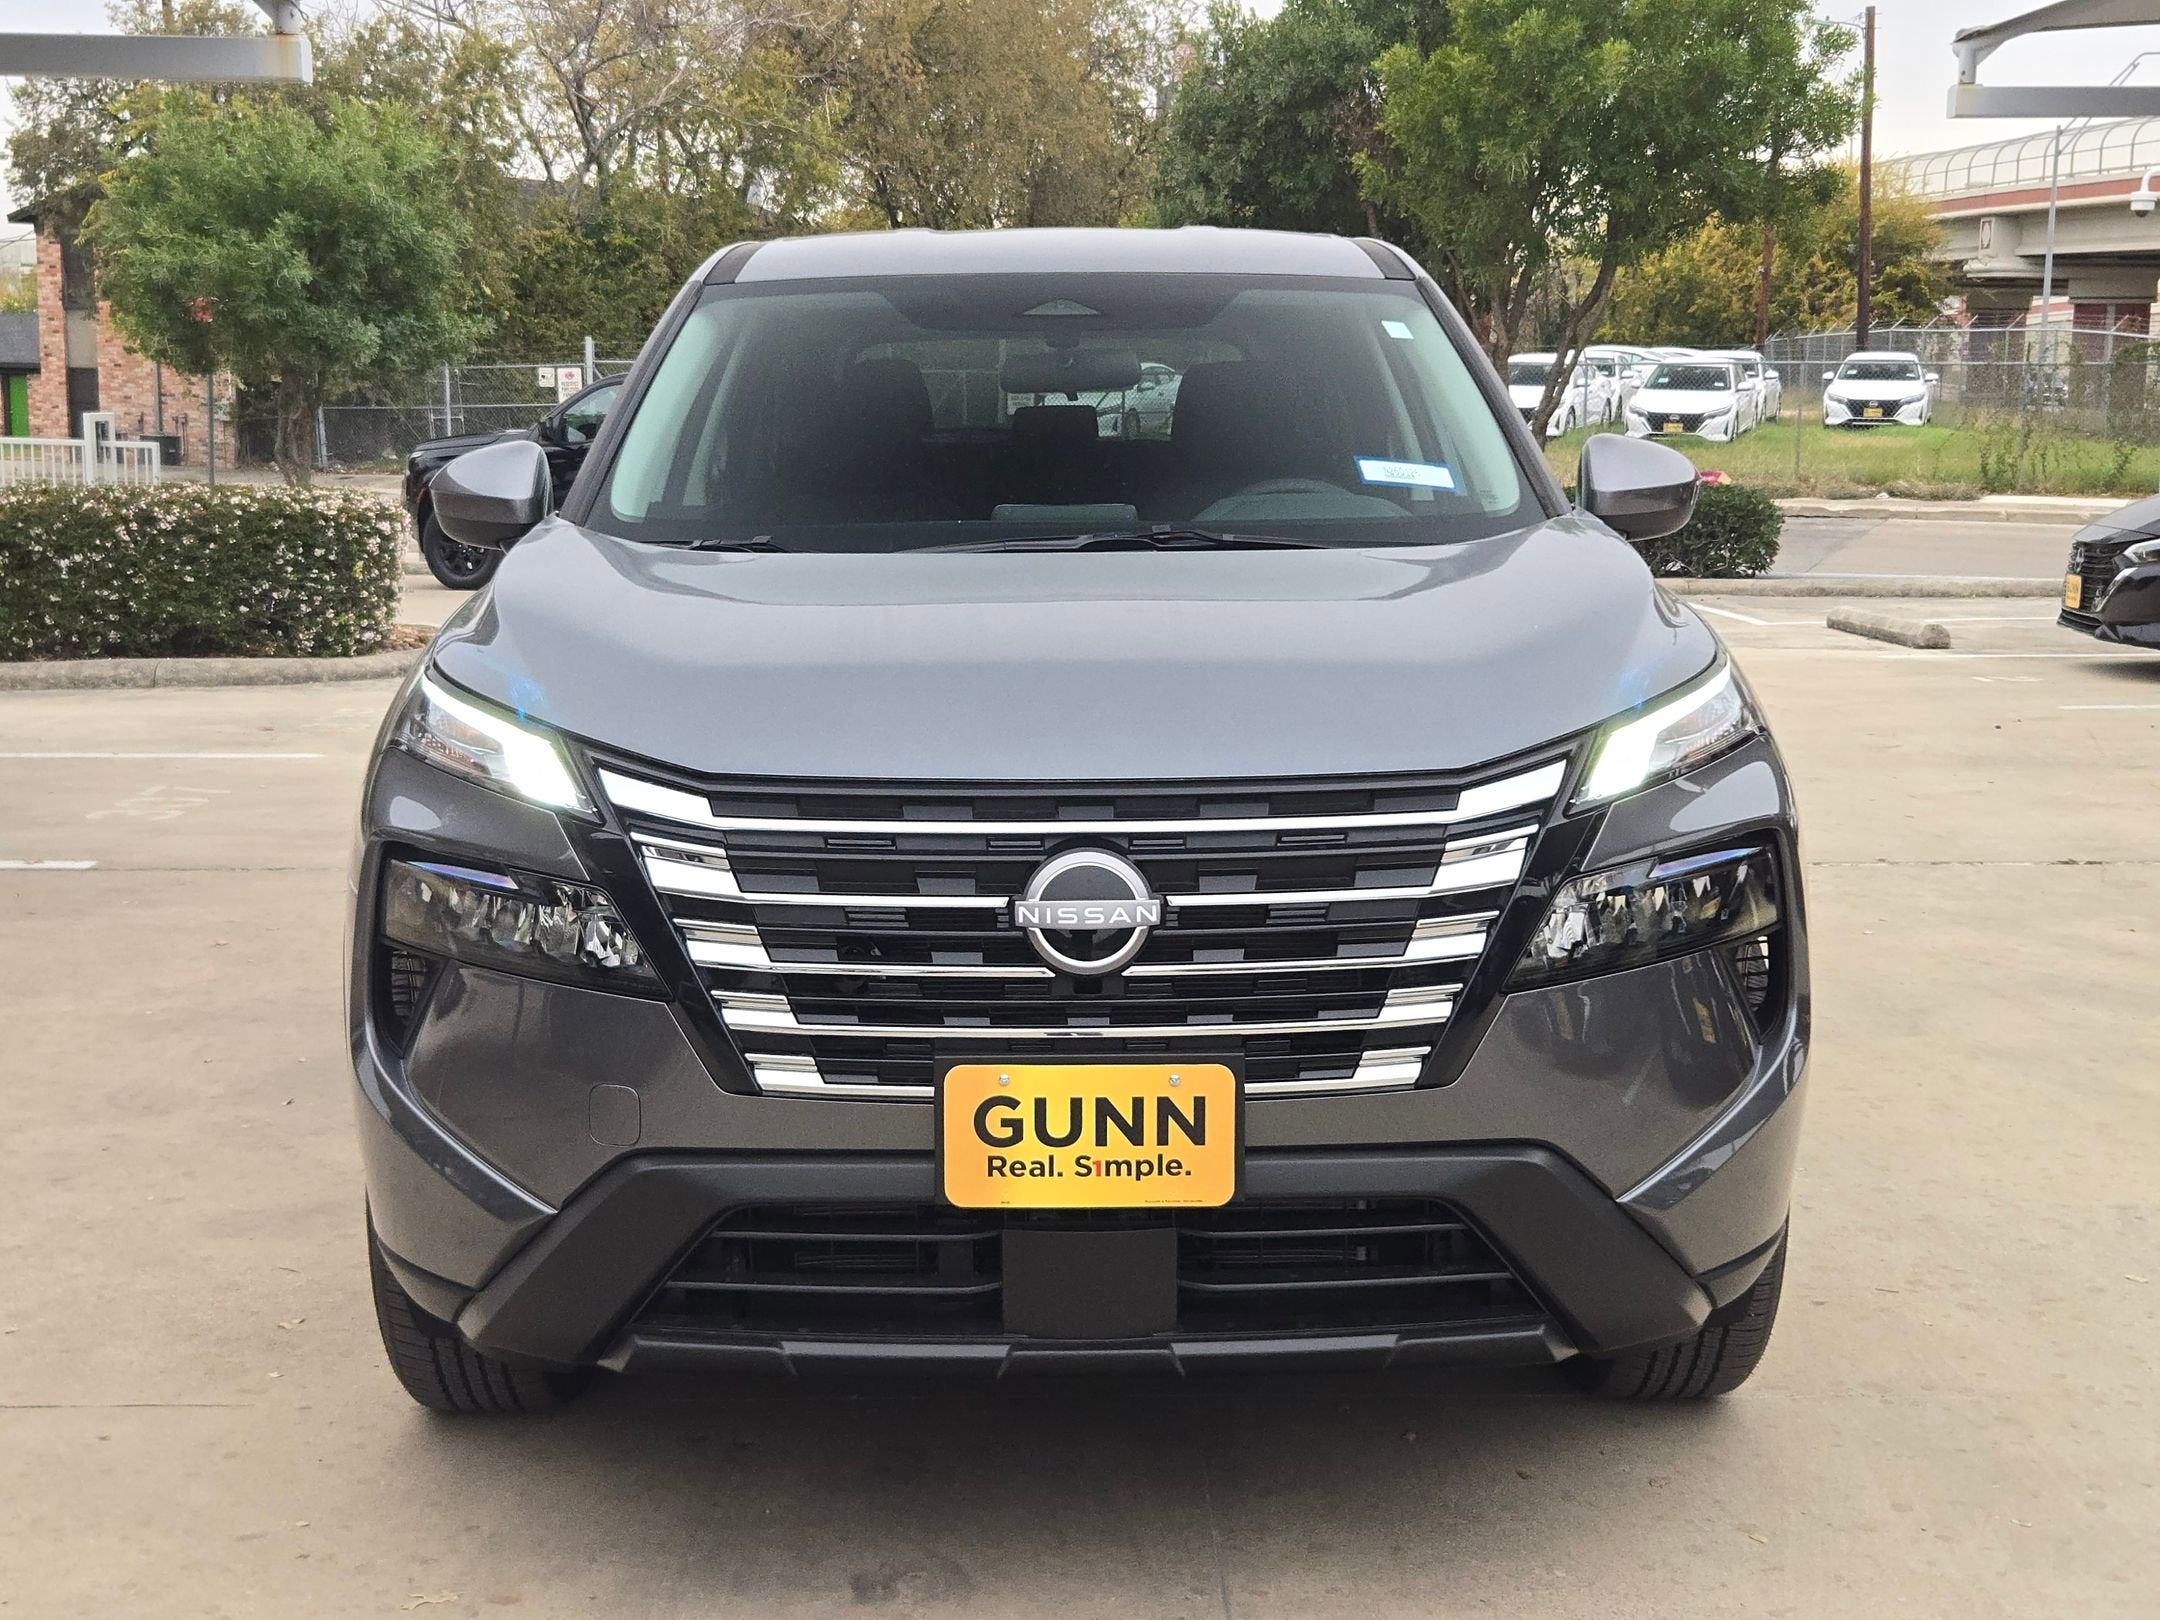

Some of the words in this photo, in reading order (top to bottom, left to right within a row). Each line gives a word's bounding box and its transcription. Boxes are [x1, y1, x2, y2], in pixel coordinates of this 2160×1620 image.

[1018, 904, 1157, 925] NISSAN
[973, 1095, 1206, 1148] GUNN
[987, 1154, 1063, 1178] Real.
